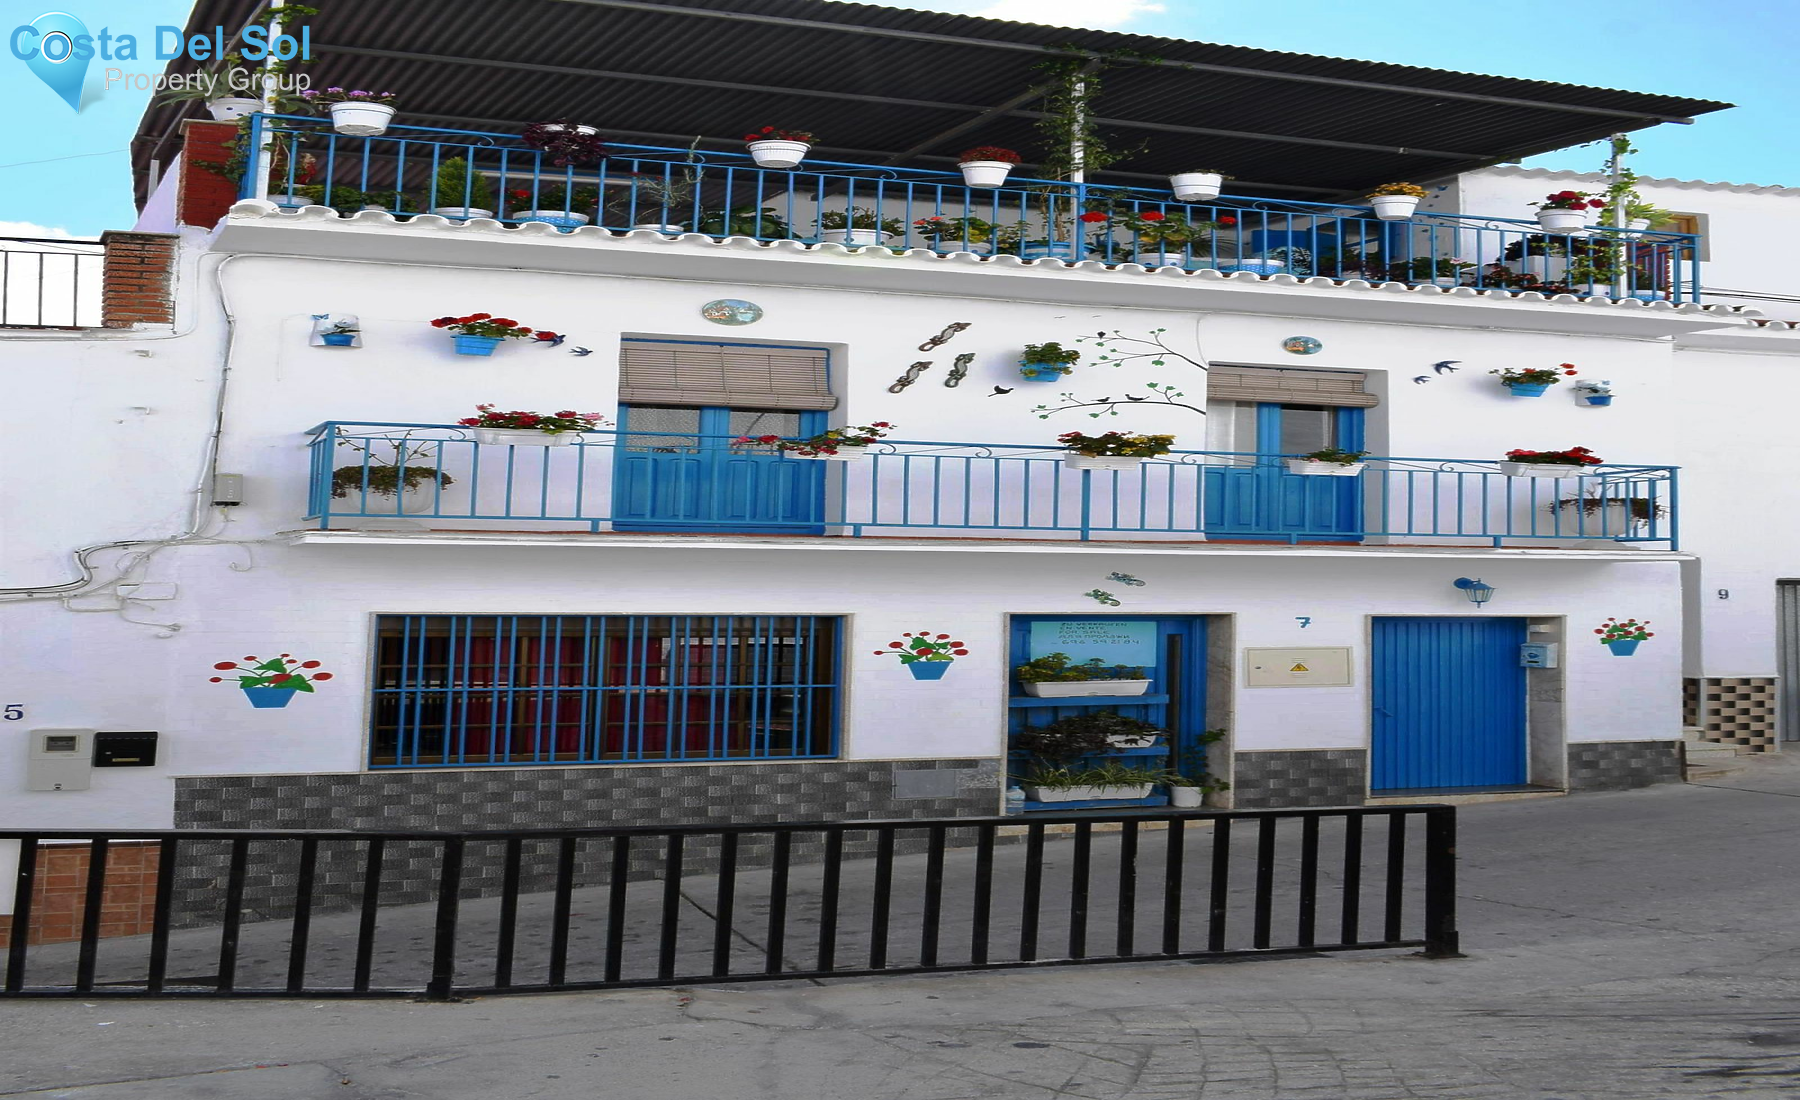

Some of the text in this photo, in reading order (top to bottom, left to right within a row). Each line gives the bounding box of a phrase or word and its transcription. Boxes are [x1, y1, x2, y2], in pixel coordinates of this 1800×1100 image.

[1718, 588, 1729, 600] 9
[1295, 616, 1312, 629] 7
[3, 703, 24, 721] 5
